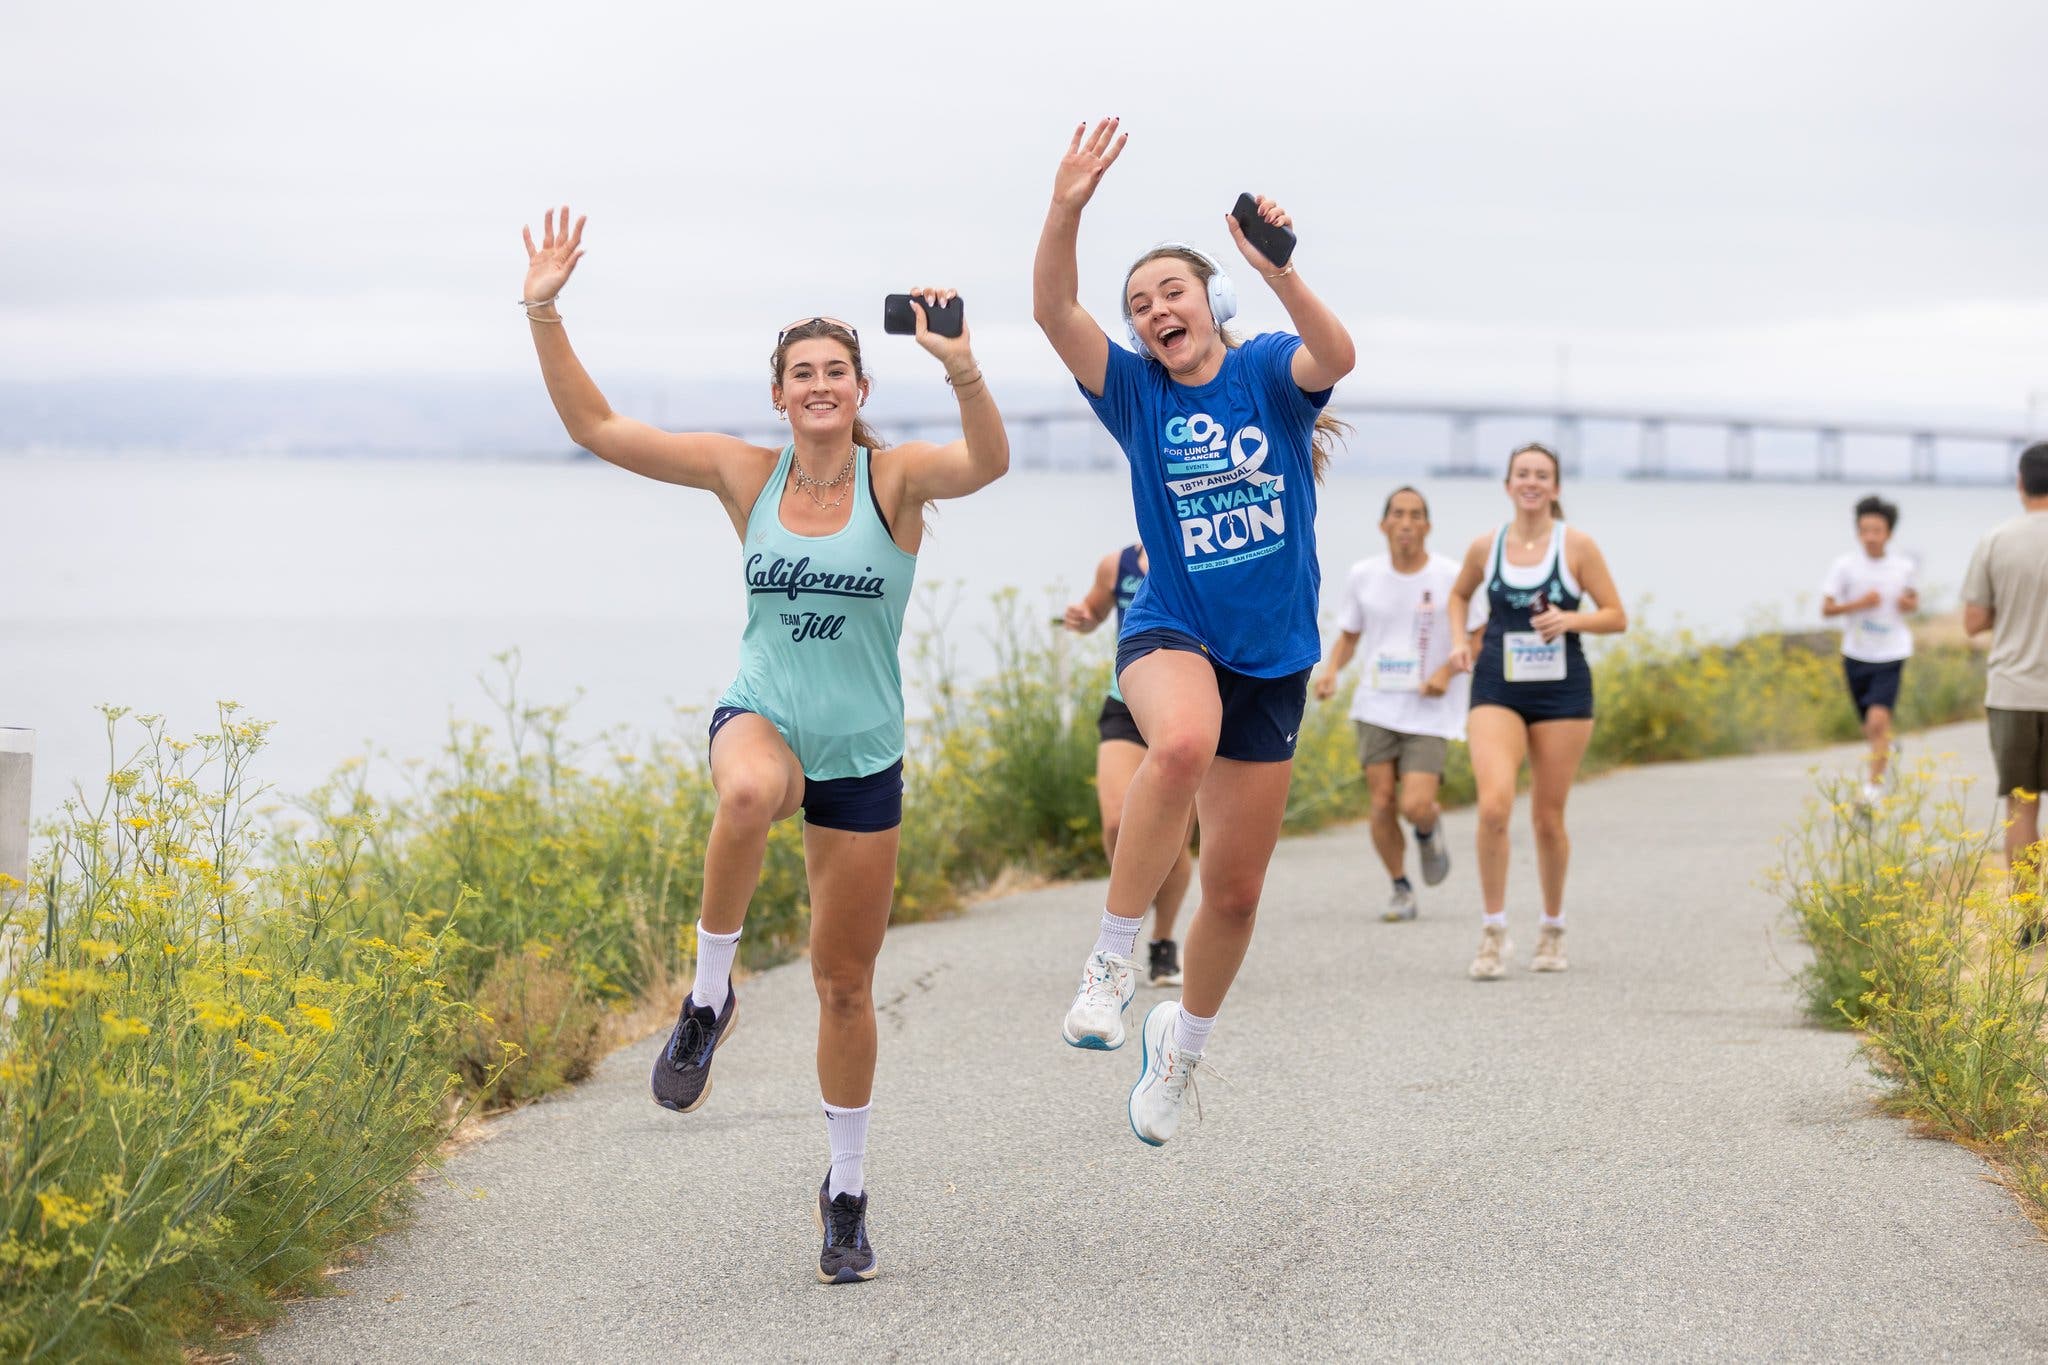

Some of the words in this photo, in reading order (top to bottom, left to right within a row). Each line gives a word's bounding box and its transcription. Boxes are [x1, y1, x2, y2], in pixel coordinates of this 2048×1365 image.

[1165, 413, 1227, 451] GO2
[1163, 447, 1183, 456] FOR
[1184, 445, 1209, 456] LUNG
[1183, 452, 1220, 461] CANCER
[1180, 480, 1204, 492] 18TH
[1206, 466, 1251, 487] ANNUAL
[1185, 463, 1209, 471] EVENTS
[1176, 496, 1208, 517] 5K
[1208, 479, 1279, 512] WALK
[1179, 498, 1285, 558] RUN
[745, 553, 886, 601] California
[1190, 562, 1204, 571] SEPT
[1233, 555, 1246, 563] SAN
[779, 613, 801, 626] TEAM
[792, 612, 846, 643] Jill
